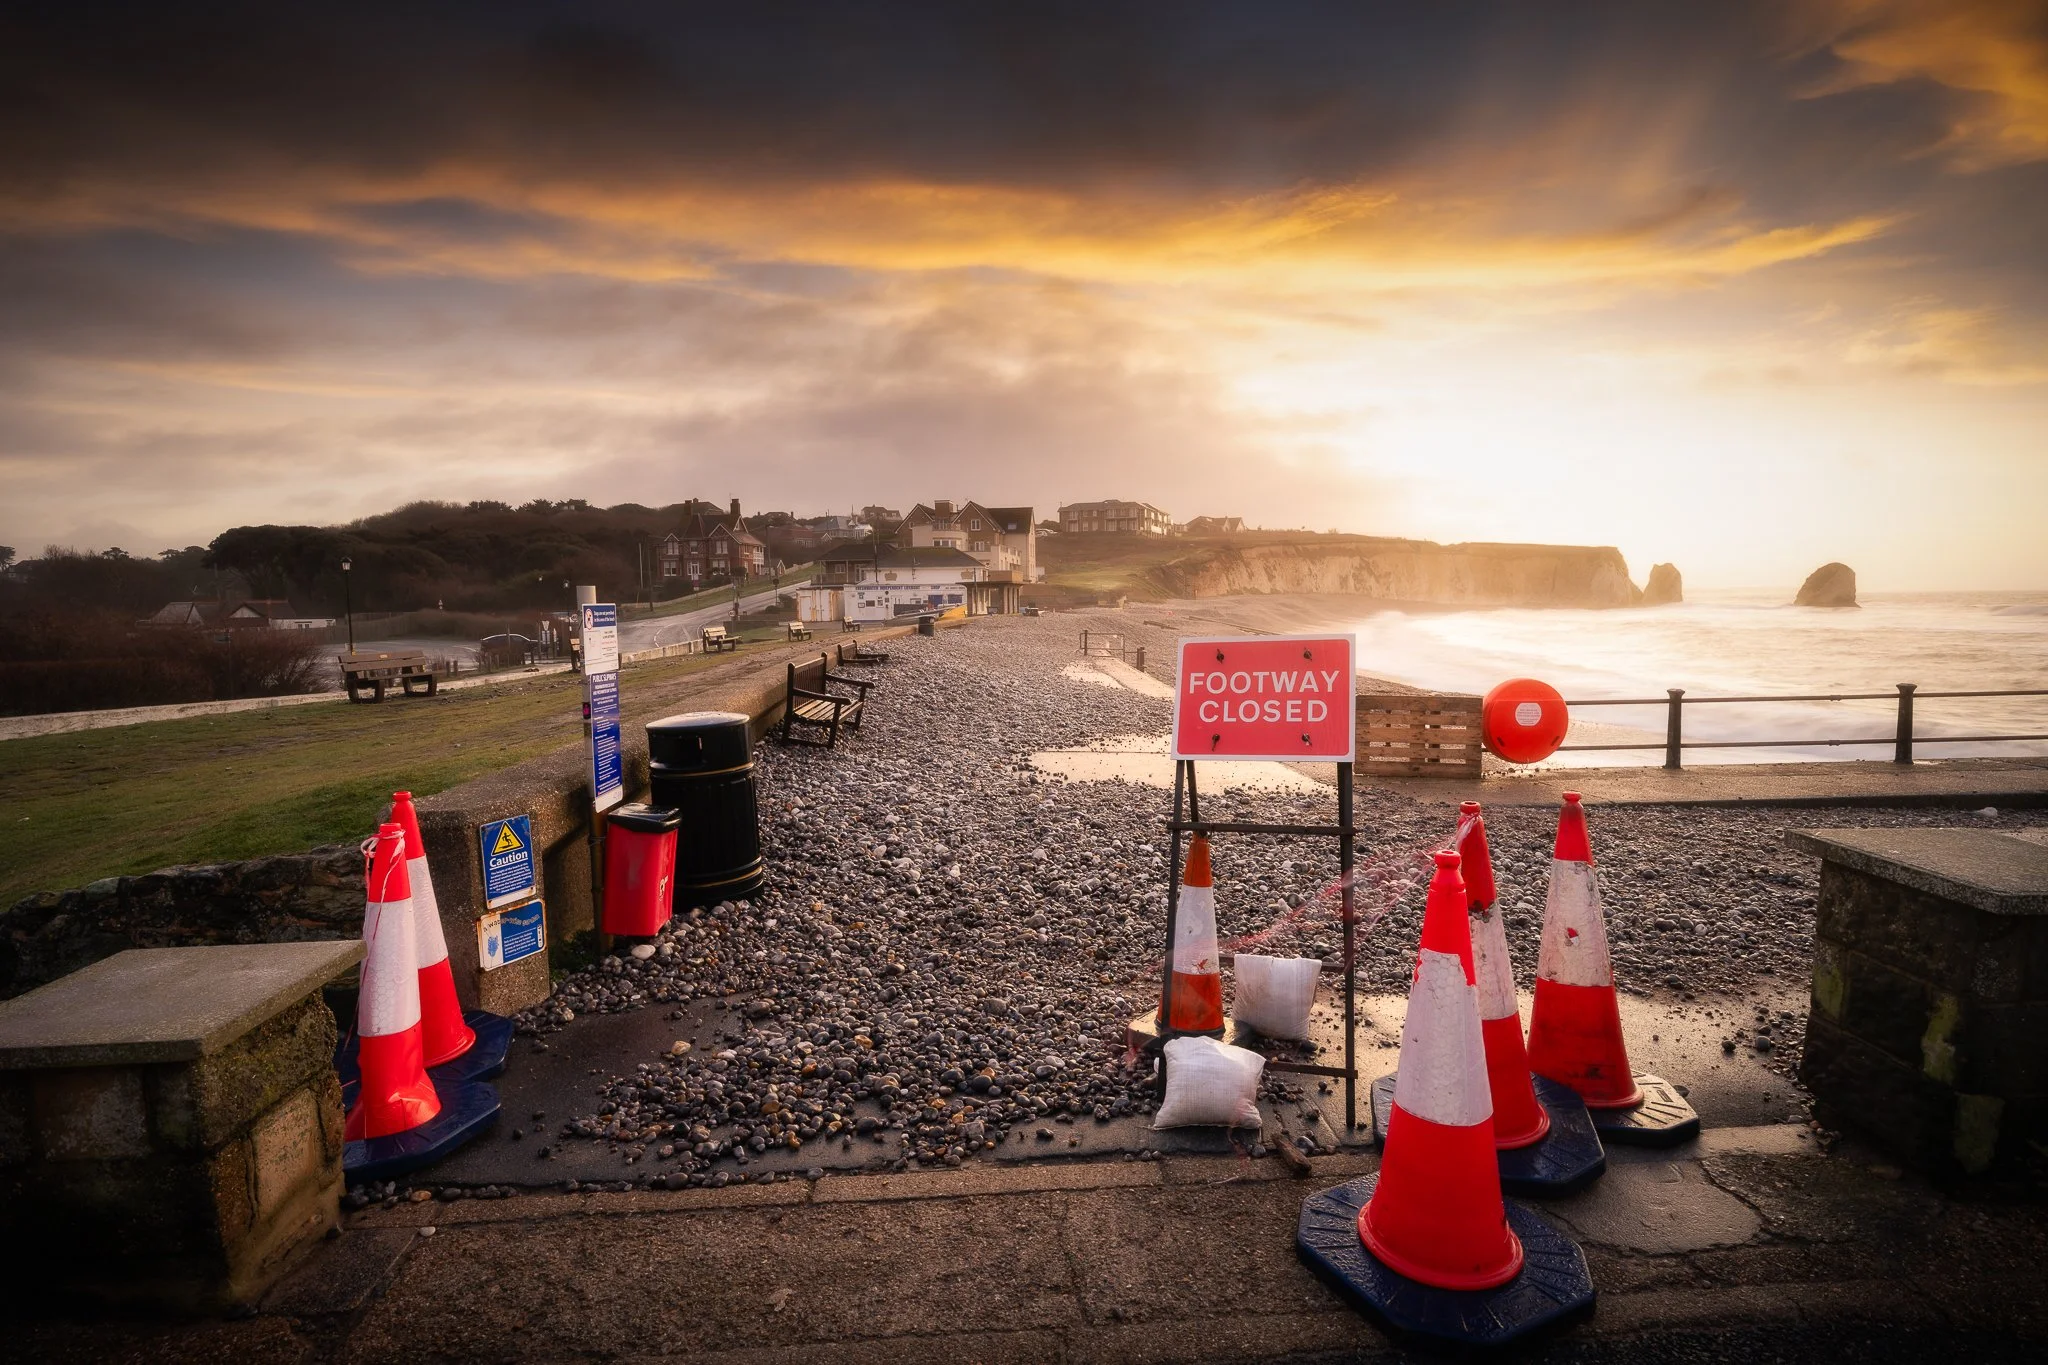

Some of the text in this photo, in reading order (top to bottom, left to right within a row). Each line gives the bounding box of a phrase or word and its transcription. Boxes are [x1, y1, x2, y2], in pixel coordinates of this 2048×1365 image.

[1189, 670, 1340, 694] FOOTWAY
[1200, 700, 1328, 723] CLOSED
[490, 851, 528, 868] Caution
